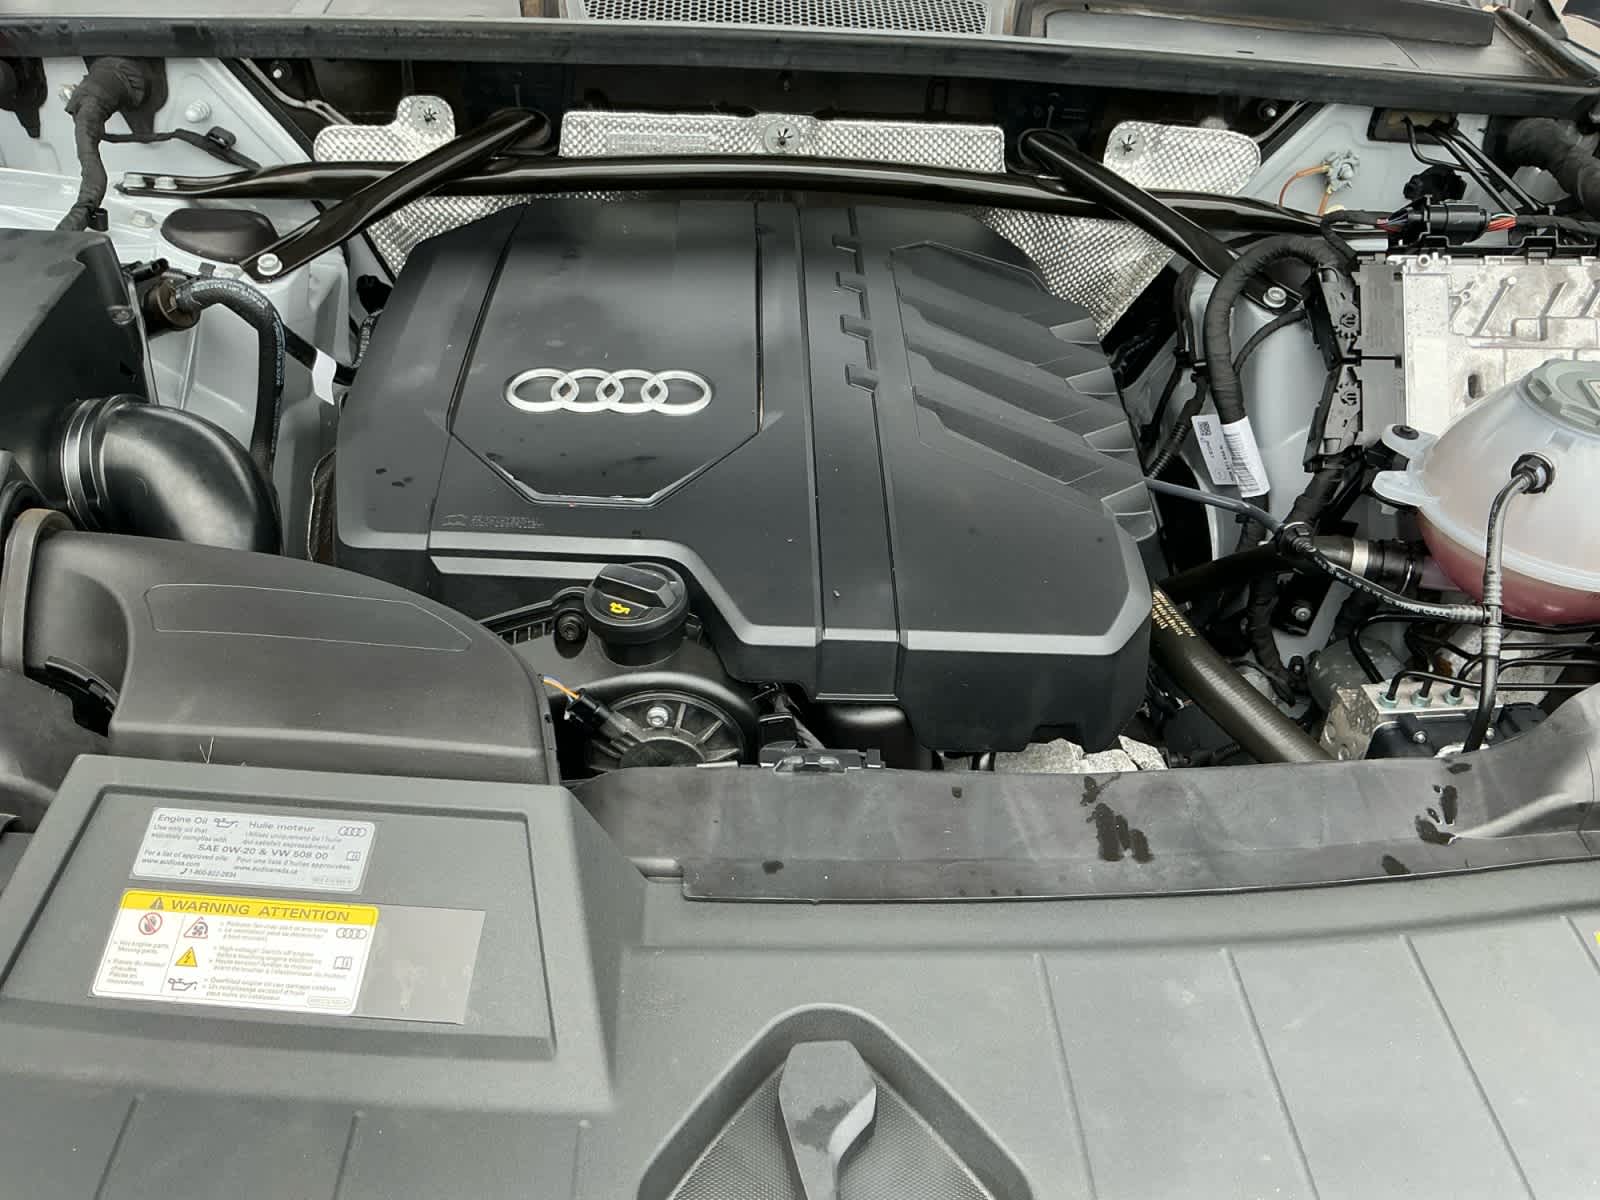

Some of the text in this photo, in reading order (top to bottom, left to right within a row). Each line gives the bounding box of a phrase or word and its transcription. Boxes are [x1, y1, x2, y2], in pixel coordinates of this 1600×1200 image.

[158, 814, 208, 825] Engine Oil
[249, 821, 316, 833] Huile moteur
[198, 844, 220, 852] SAE
[222, 846, 256, 854] 0W-20
[272, 849, 290, 857] VW
[292, 850, 313, 858] 508
[315, 852, 329, 860] 00
[171, 900, 351, 922] WARNING ATTENTION
